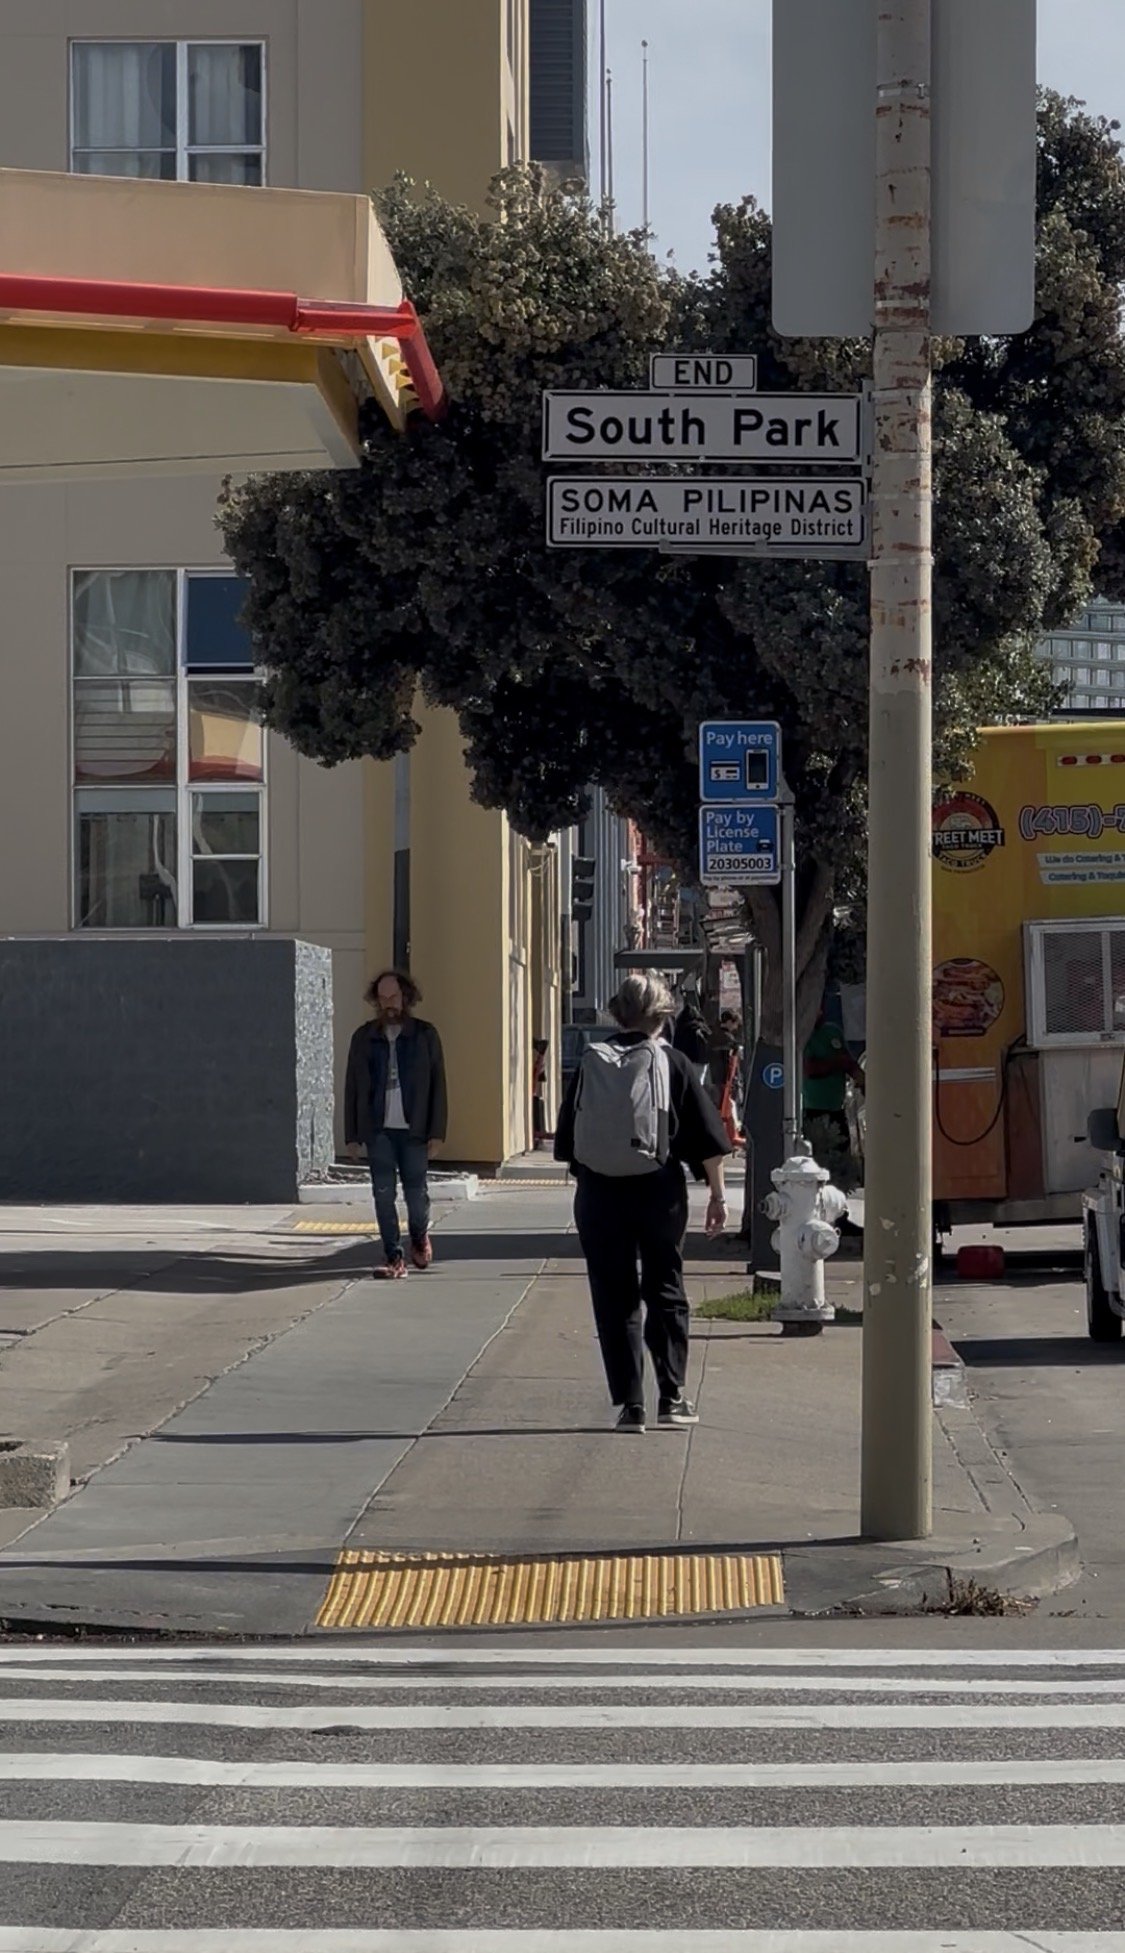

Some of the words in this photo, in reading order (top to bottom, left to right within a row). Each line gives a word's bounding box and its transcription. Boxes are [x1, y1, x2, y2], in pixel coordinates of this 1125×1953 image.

[674, 360, 733, 385] END
[566, 406, 706, 446] South
[733, 408, 840, 447] Park
[561, 488, 658, 513] SOMA
[683, 489, 853, 514] PILIPINAS
[560, 517, 624, 538] Filipino
[631, 517, 701, 536] Cultural
[709, 517, 782, 540] Heritage
[791, 518, 854, 537] District
[706, 731, 735, 749] Pay
[737, 731, 773, 745] here
[706, 811, 732, 827] Pay
[736, 811, 754, 827] by
[706, 825, 759, 838] License
[932, 831, 967, 846] REET
[968, 829, 1004, 846] MEET
[706, 839, 744, 853] Plate
[709, 857, 772, 870] 20305003
[770, 1067, 783, 1084] P
